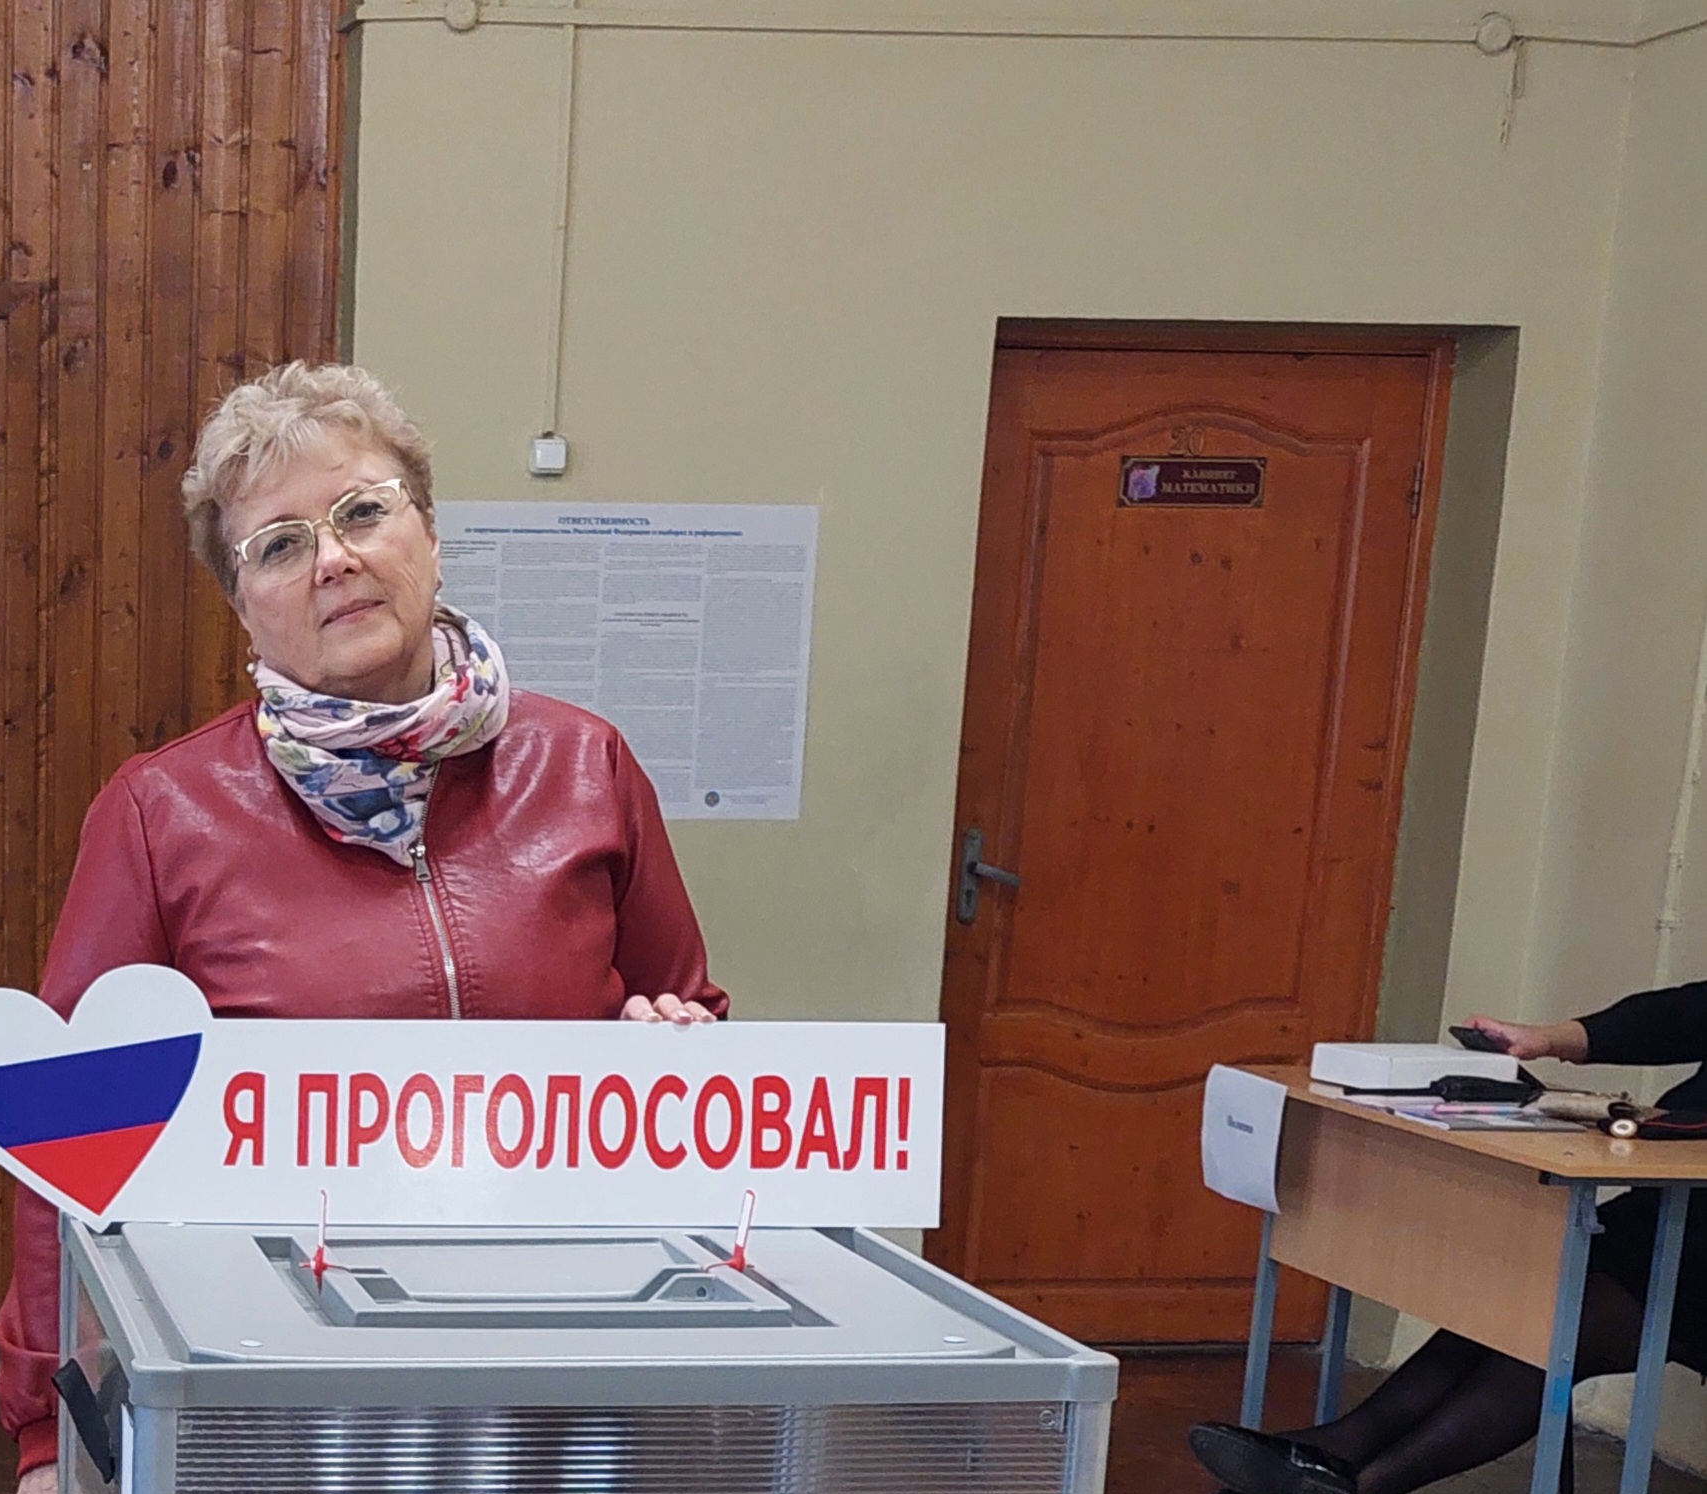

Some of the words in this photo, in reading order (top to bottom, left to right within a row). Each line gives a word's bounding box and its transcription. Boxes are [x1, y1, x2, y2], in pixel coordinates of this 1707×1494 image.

[1168, 427, 1205, 456] 20
[223, 1071, 266, 1166] Я
[296, 1072, 911, 1171] ПРОГОЛОСОВАЛ!
